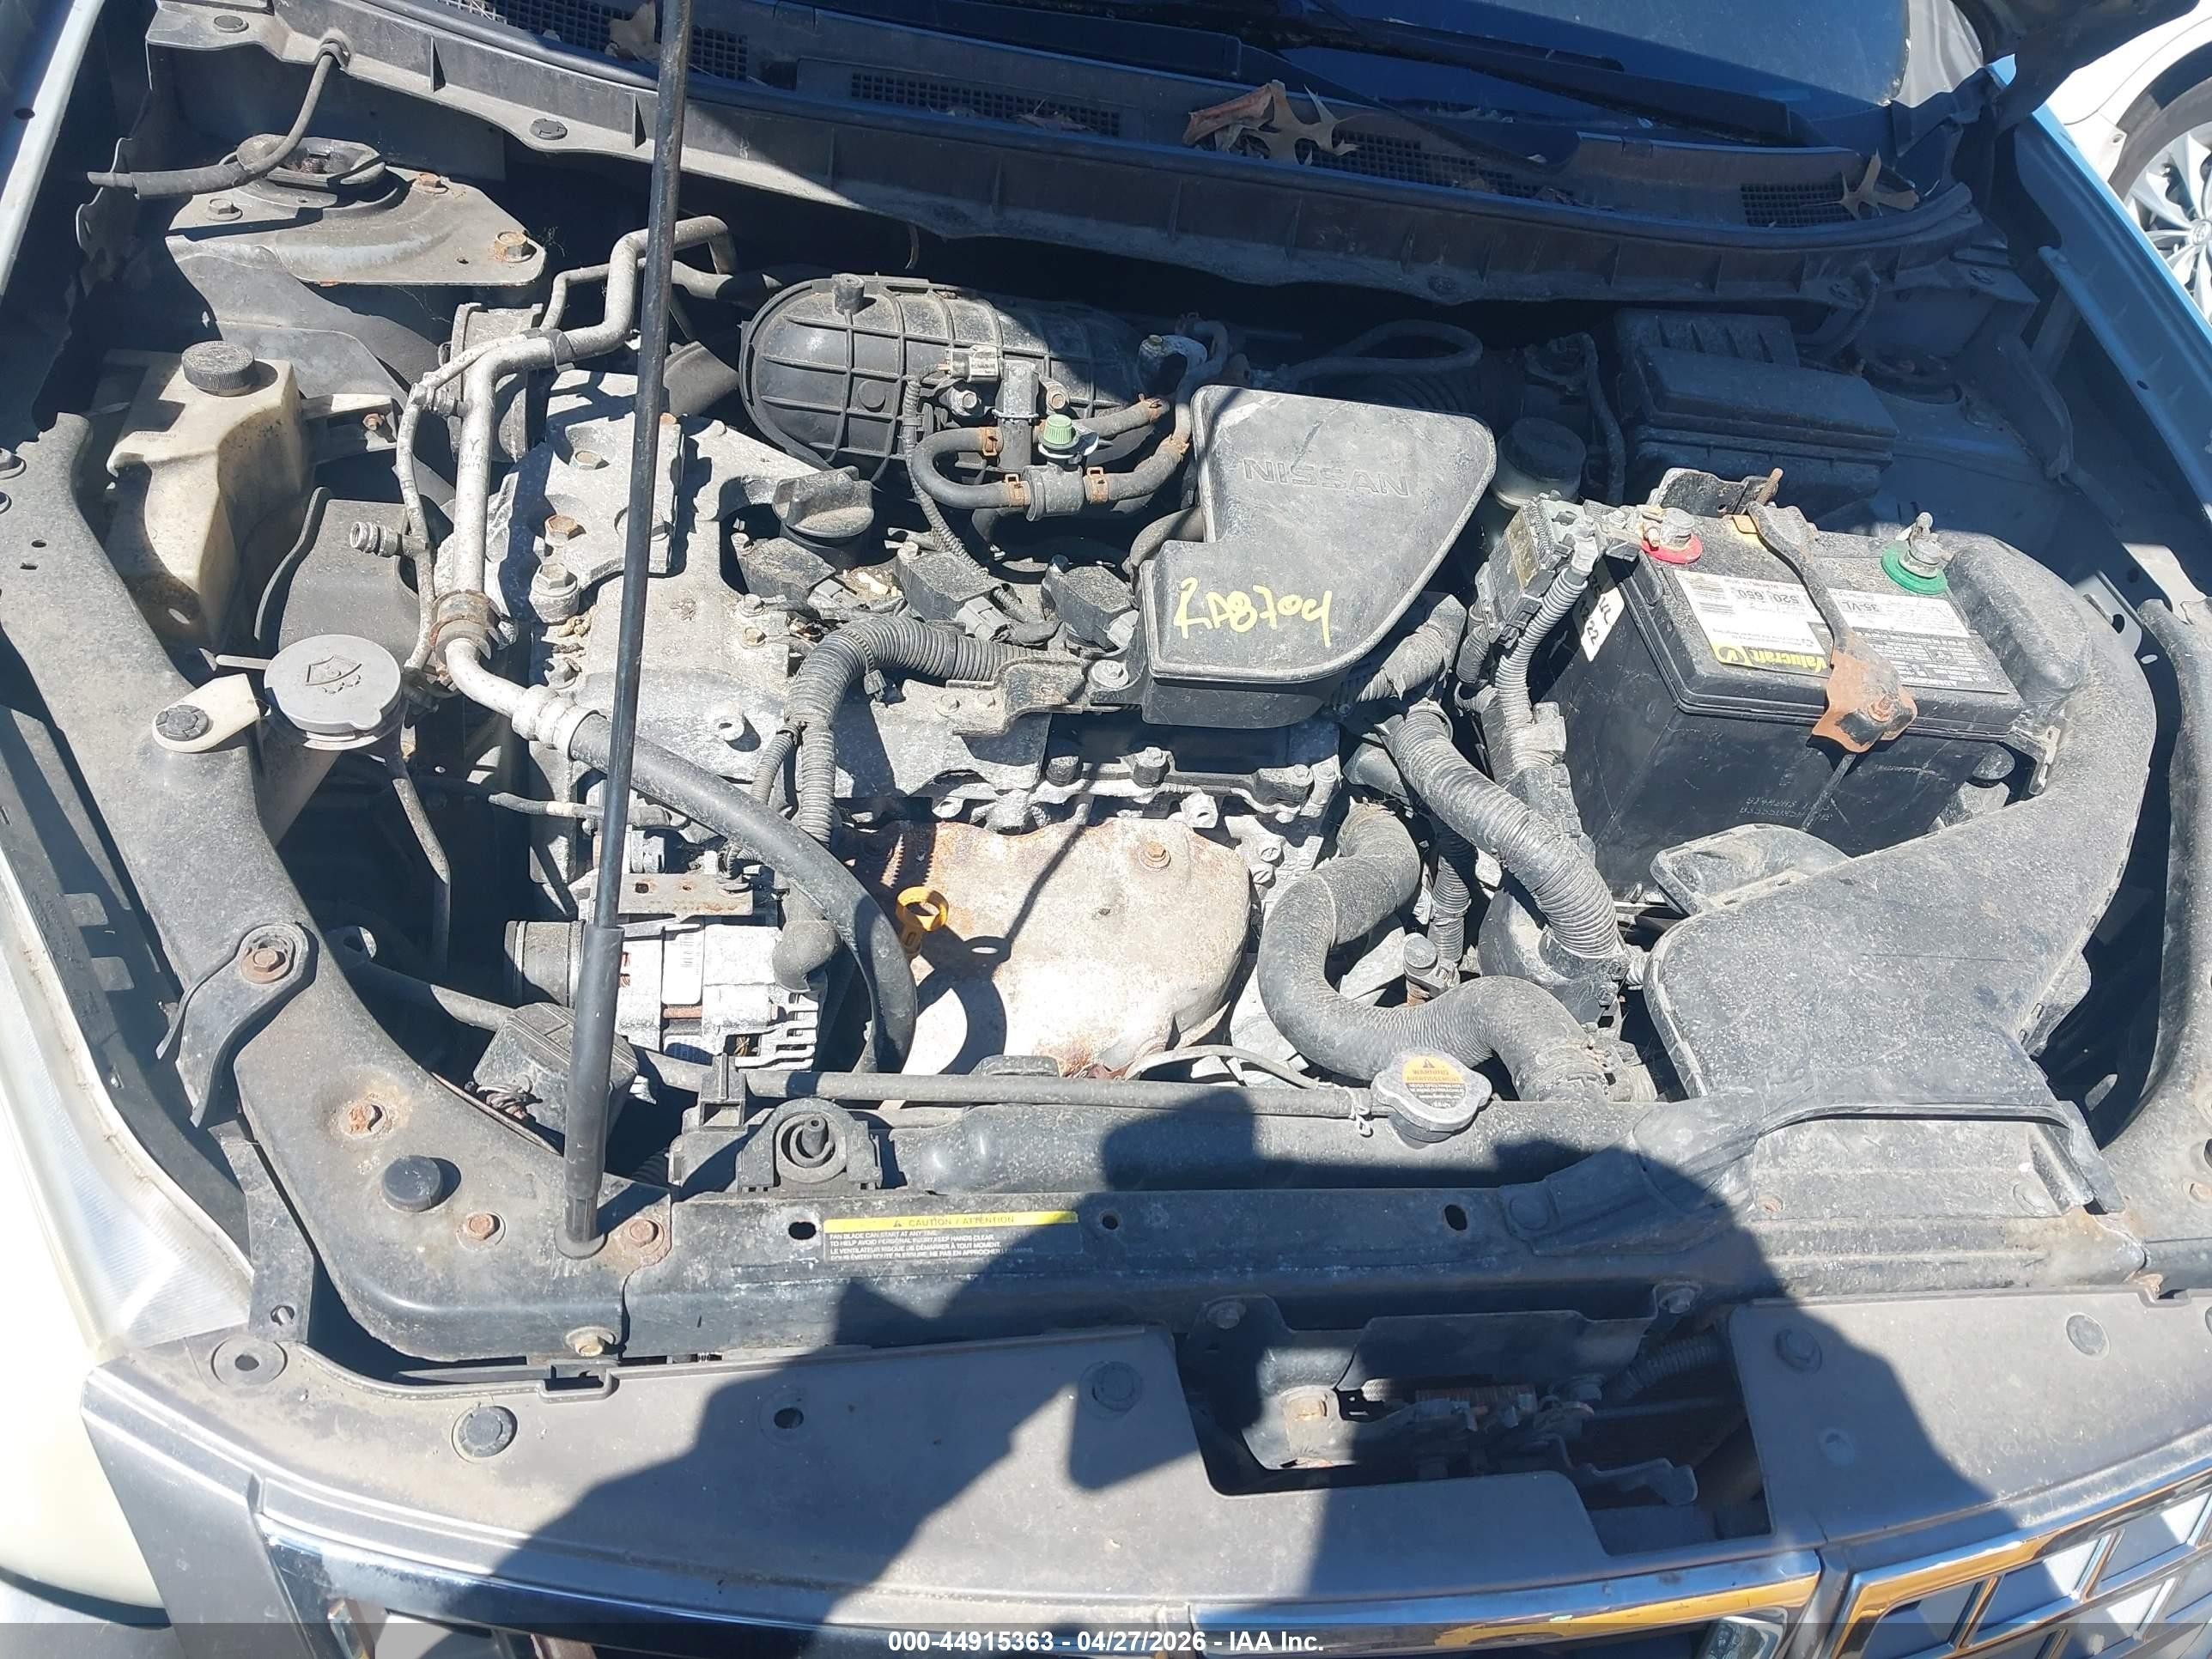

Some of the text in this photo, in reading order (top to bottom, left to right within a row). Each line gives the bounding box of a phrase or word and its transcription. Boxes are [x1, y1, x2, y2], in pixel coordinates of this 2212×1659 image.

[1243, 459, 1409, 496] NISSAN
[1738, 589, 1800, 605] 520 650
[1842, 600, 1881, 612] 35-VL
[1749, 648, 1828, 673] Valucraft
[908, 1218, 951, 1227] CAUTION
[963, 1216, 1013, 1224] ATTENTION
